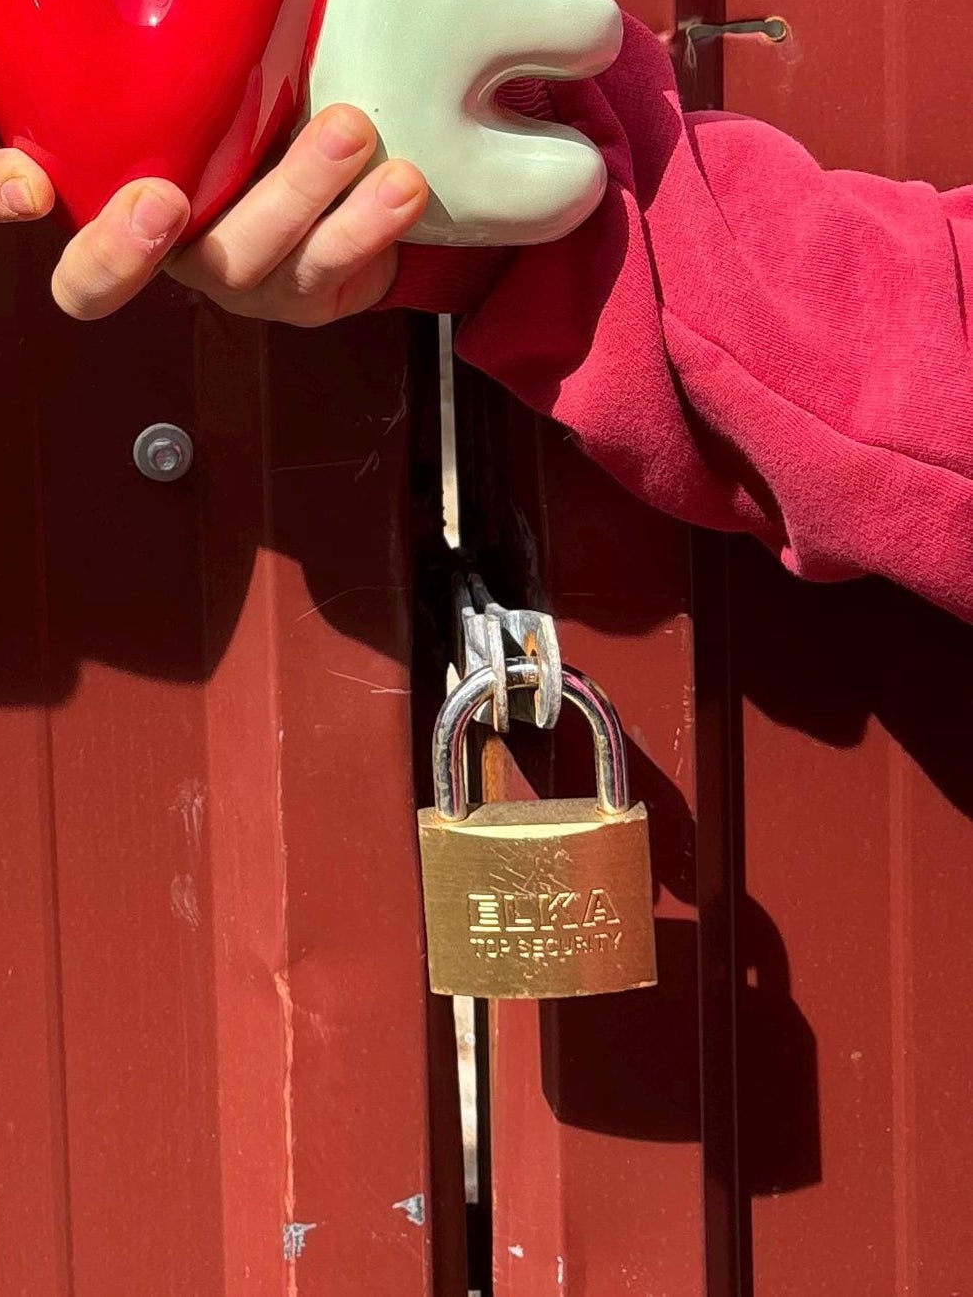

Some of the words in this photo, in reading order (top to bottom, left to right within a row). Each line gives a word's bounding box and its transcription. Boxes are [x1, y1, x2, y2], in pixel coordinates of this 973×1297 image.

[468, 889, 621, 932] ELKA
[469, 936, 511, 959] TOP
[518, 931, 623, 959] SECURITY
